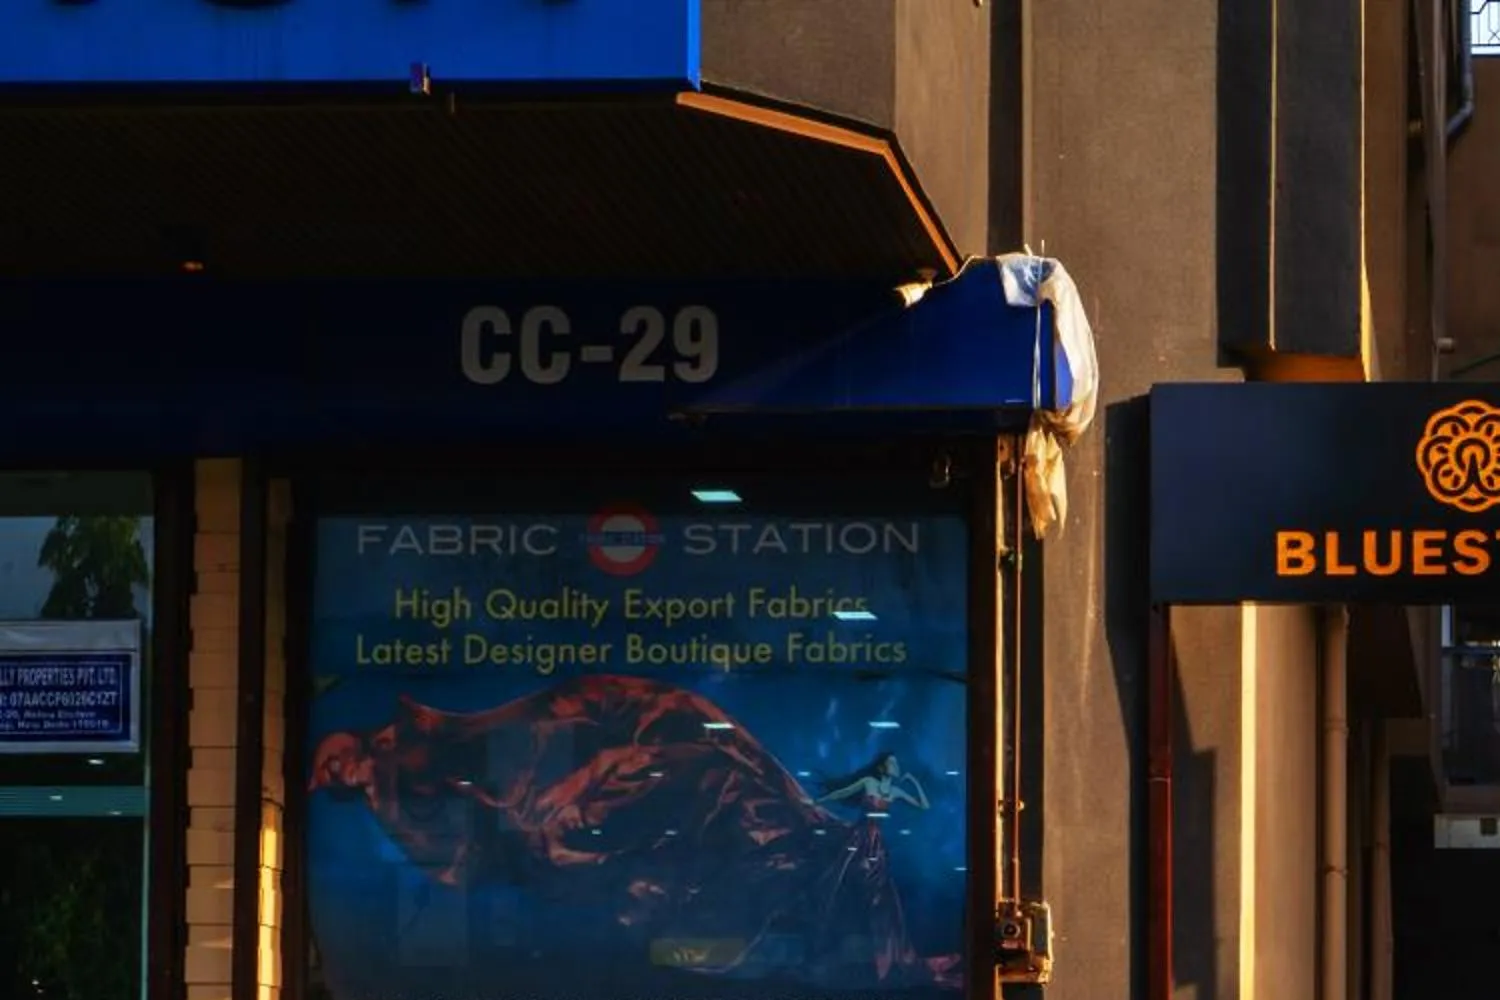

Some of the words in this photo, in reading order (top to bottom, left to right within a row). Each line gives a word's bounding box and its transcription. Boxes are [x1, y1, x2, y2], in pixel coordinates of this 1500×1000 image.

[460, 305, 720, 385] CC-29
[356, 524, 559, 556] FABRIC
[684, 522, 921, 555] STATION
[395, 586, 472, 628] High
[485, 586, 609, 627] Quality
[624, 587, 735, 627] Export
[748, 585, 869, 619] Fabrics
[356, 633, 451, 665] Latest
[464, 632, 613, 675] Designer
[625, 632, 773, 672] Boutique
[787, 630, 908, 664] Fabrics
[18, 667, 75, 686] PROPERTIES
